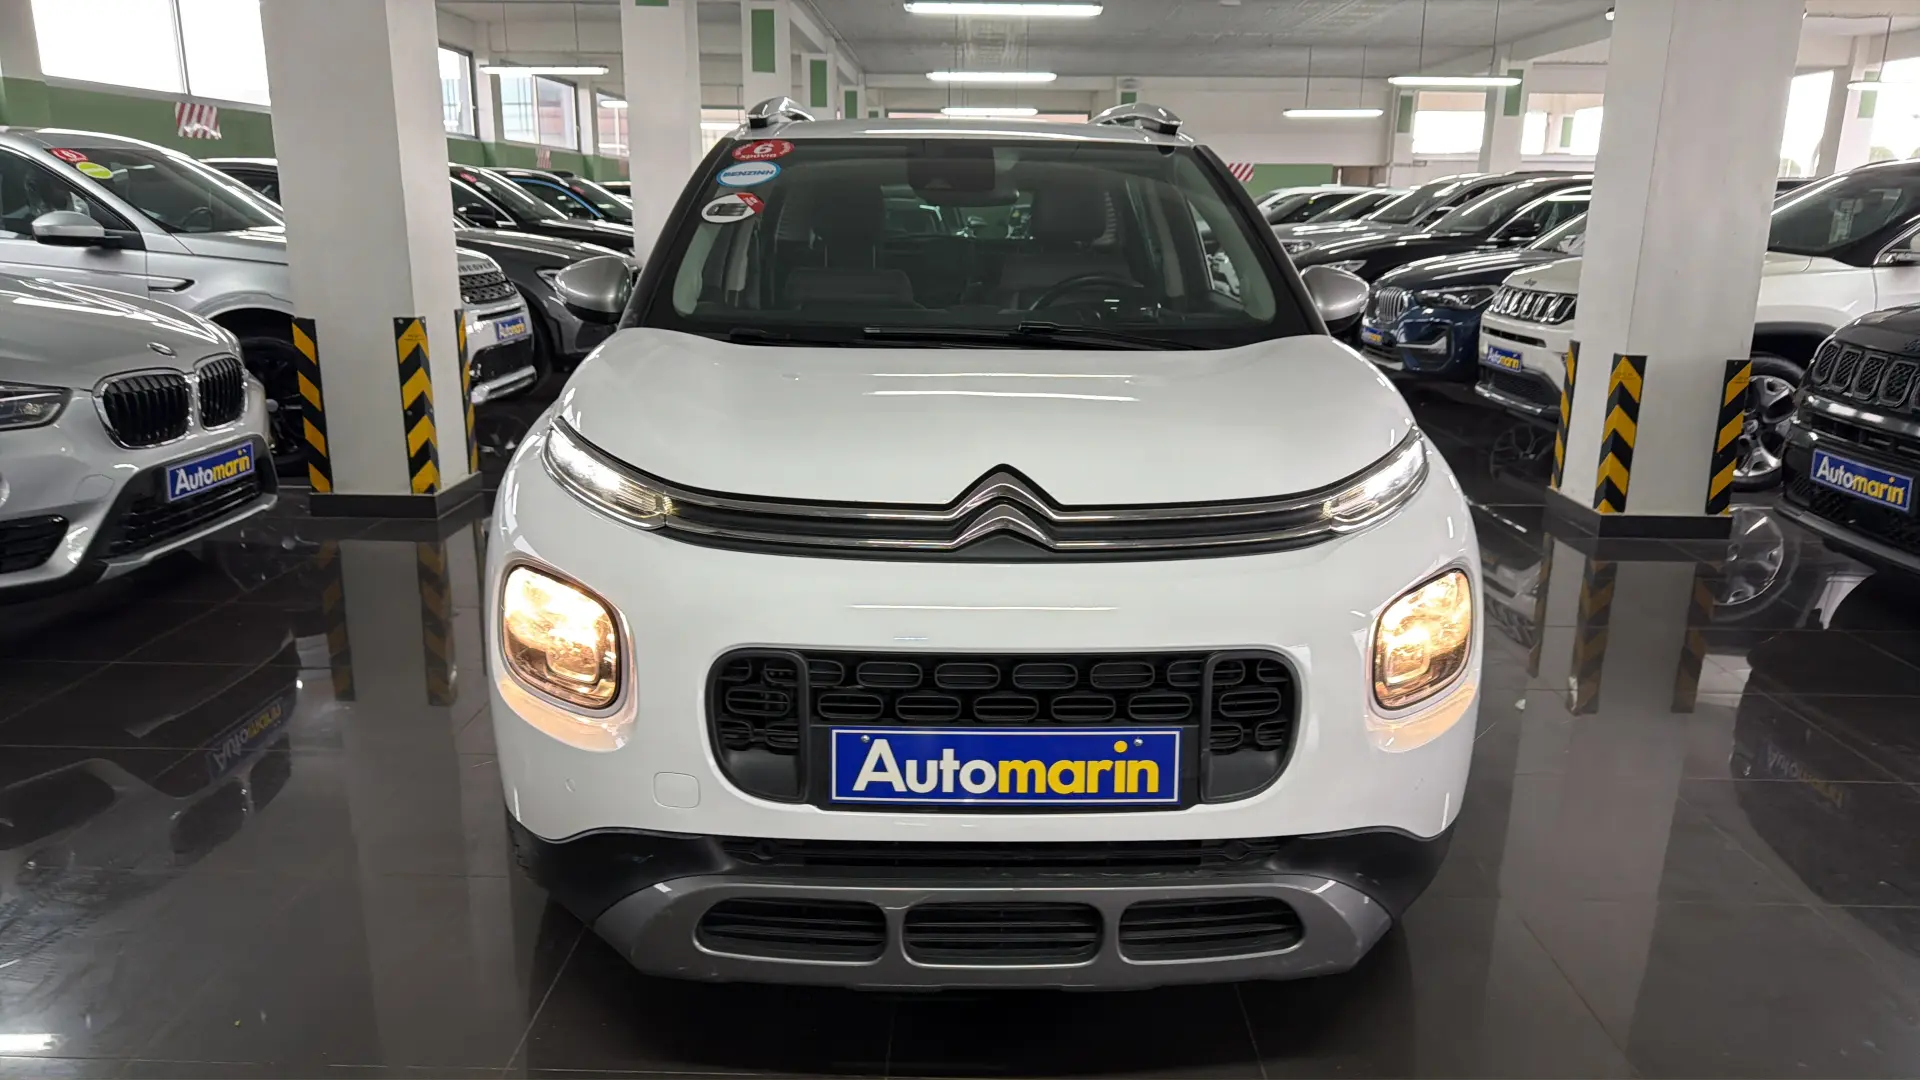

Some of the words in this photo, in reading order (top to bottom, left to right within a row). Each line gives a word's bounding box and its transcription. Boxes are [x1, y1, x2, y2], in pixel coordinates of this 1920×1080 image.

[175, 448, 251, 495] Automarin
[1816, 455, 1905, 505] Automarin
[852, 738, 1159, 795] Automarin
